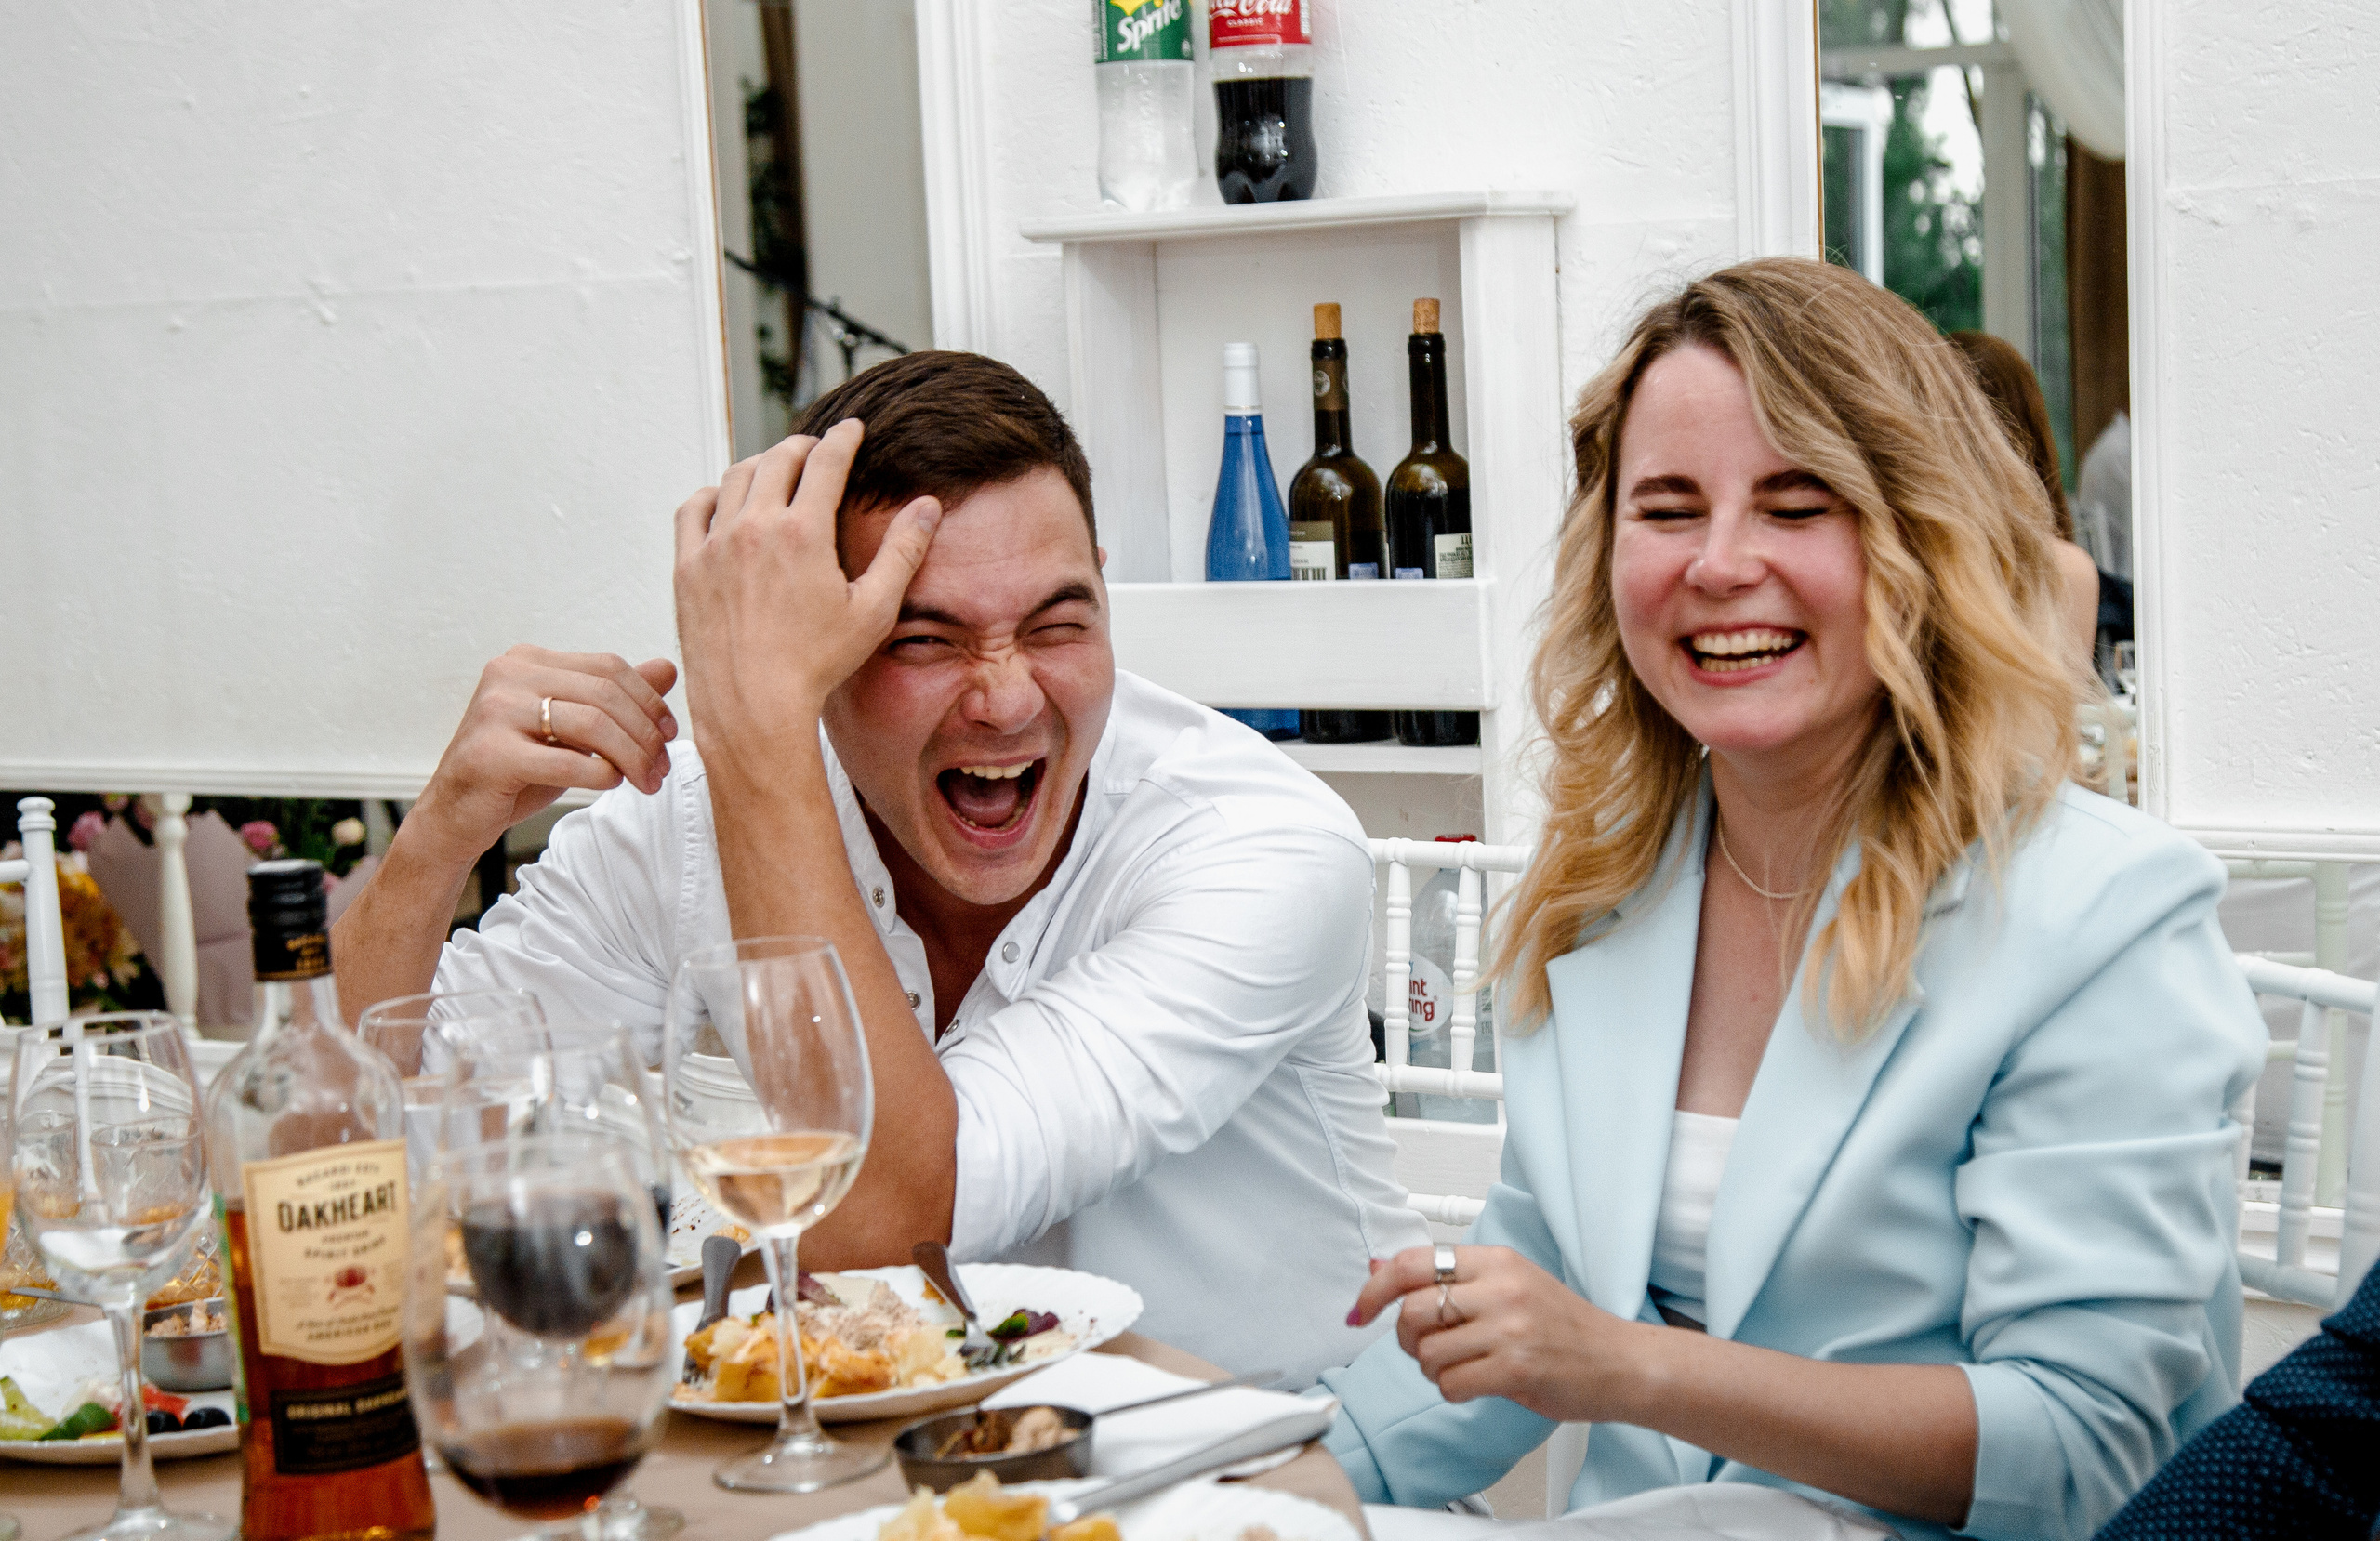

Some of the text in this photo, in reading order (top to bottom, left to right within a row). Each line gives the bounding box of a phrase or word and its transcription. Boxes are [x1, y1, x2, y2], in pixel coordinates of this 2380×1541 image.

[1117, 0, 1183, 53] Sprite
[1226, 17, 1264, 28] CLASSIC
[277, 1179, 396, 1234] OAKHEART
